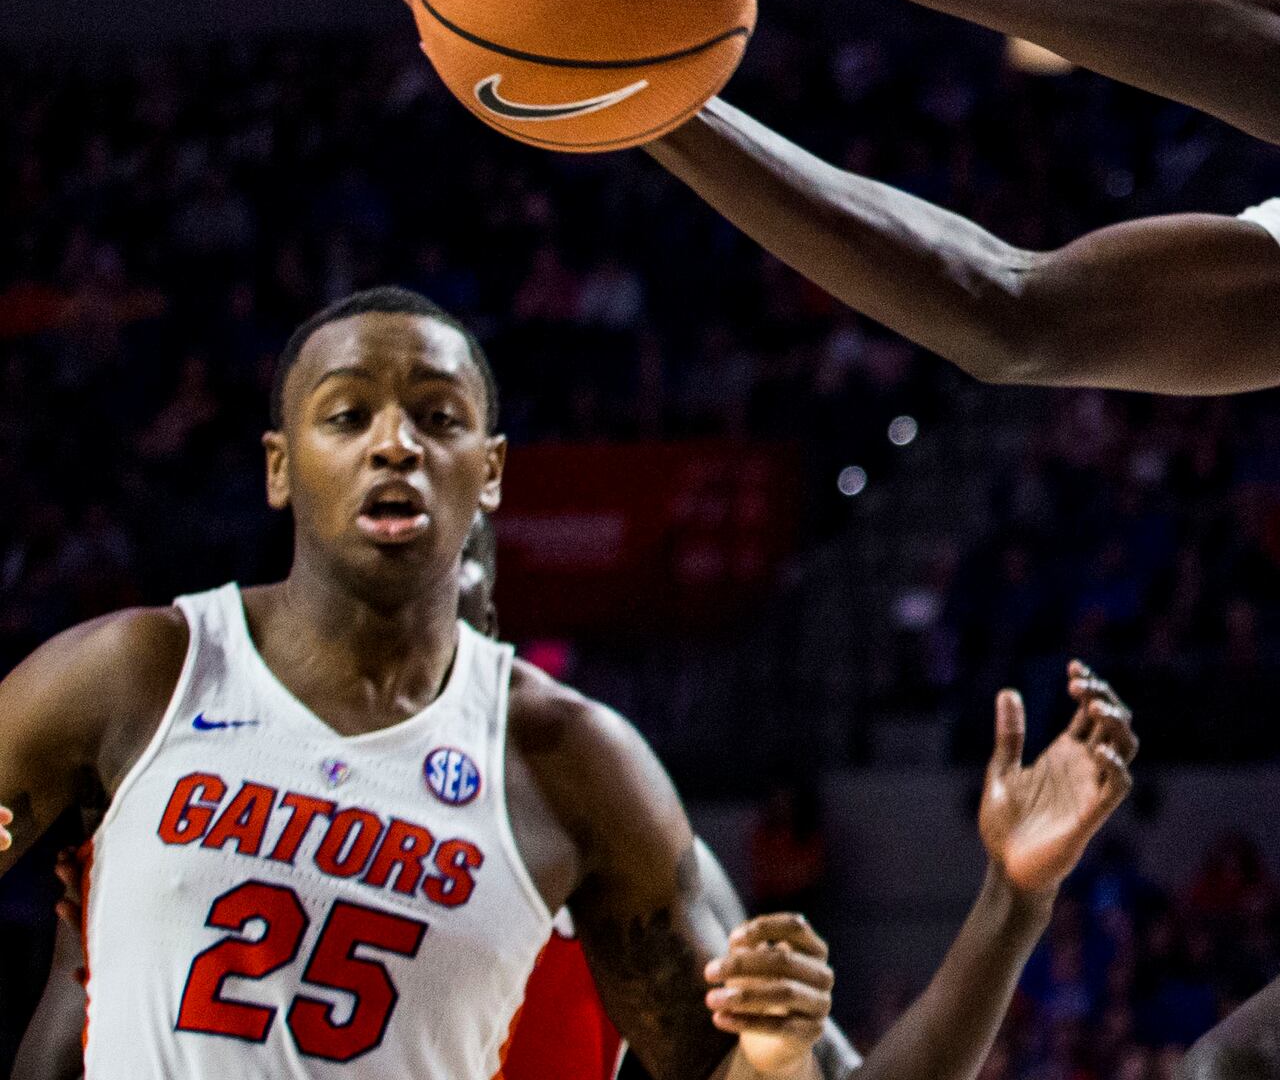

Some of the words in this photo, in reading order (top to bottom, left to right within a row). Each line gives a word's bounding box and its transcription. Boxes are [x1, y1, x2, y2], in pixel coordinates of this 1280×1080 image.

[156, 771, 485, 909] GATORS
[425, 747, 480, 804] SEC
[174, 878, 430, 1063] 25
